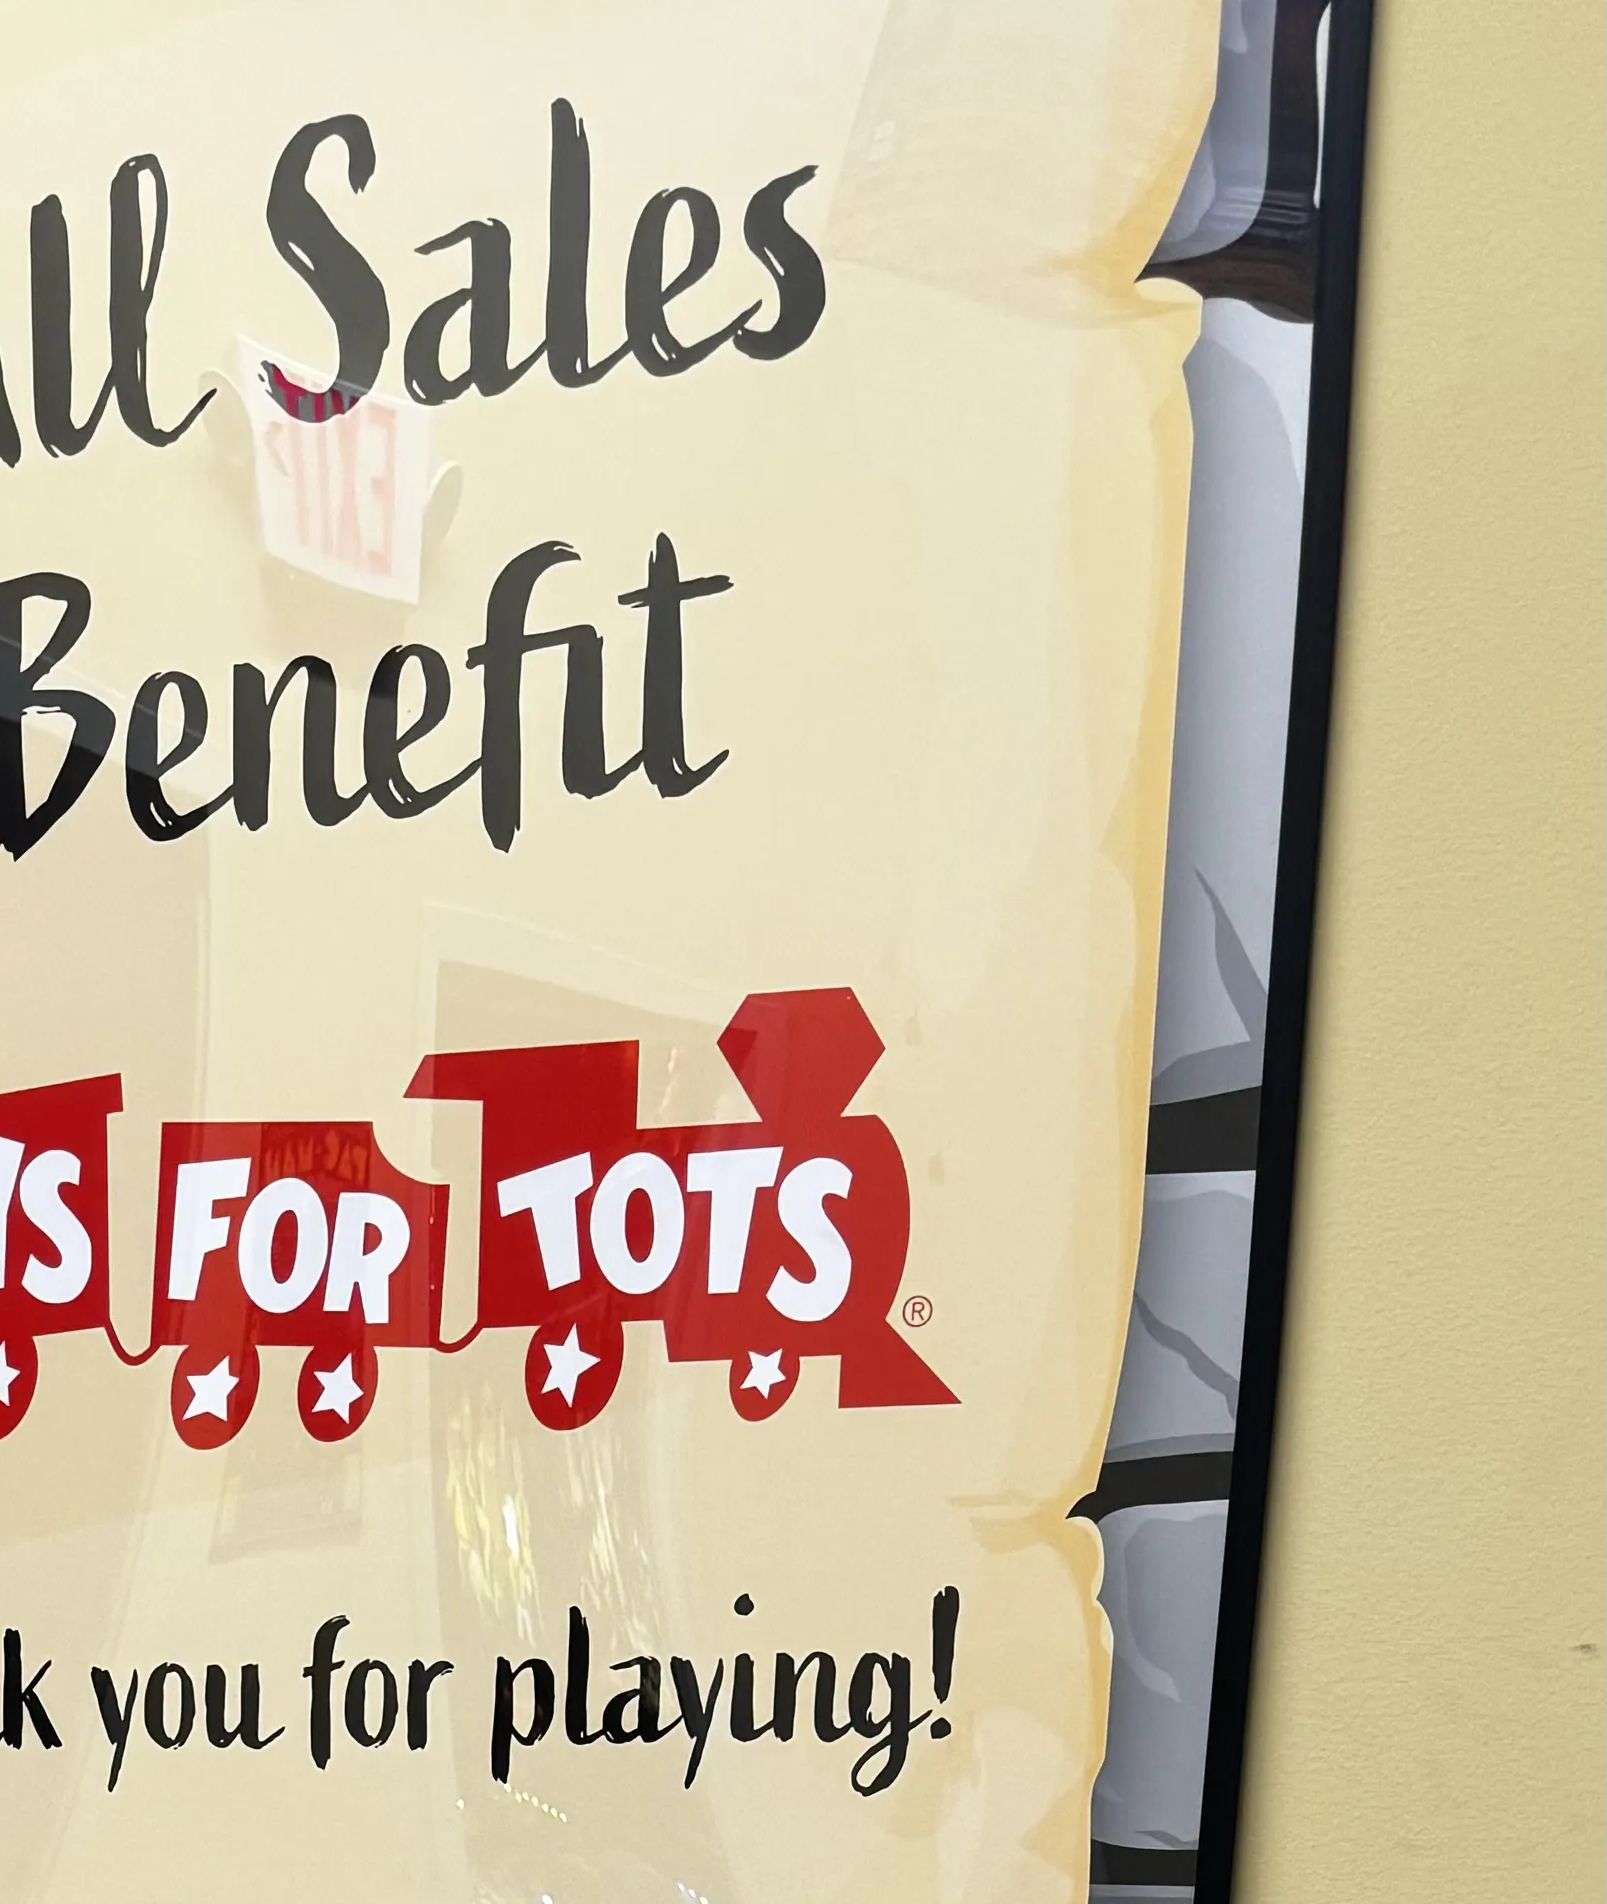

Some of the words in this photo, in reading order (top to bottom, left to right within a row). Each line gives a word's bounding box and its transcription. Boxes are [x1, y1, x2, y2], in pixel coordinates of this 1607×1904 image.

[261, 98, 826, 422] Sales
[167, 1157, 411, 1324] FOR
[497, 1146, 853, 1333] TOTS
[89, 1662, 286, 1793] you
[302, 1614, 455, 1769] for
[491, 1585, 960, 1798] playing!
